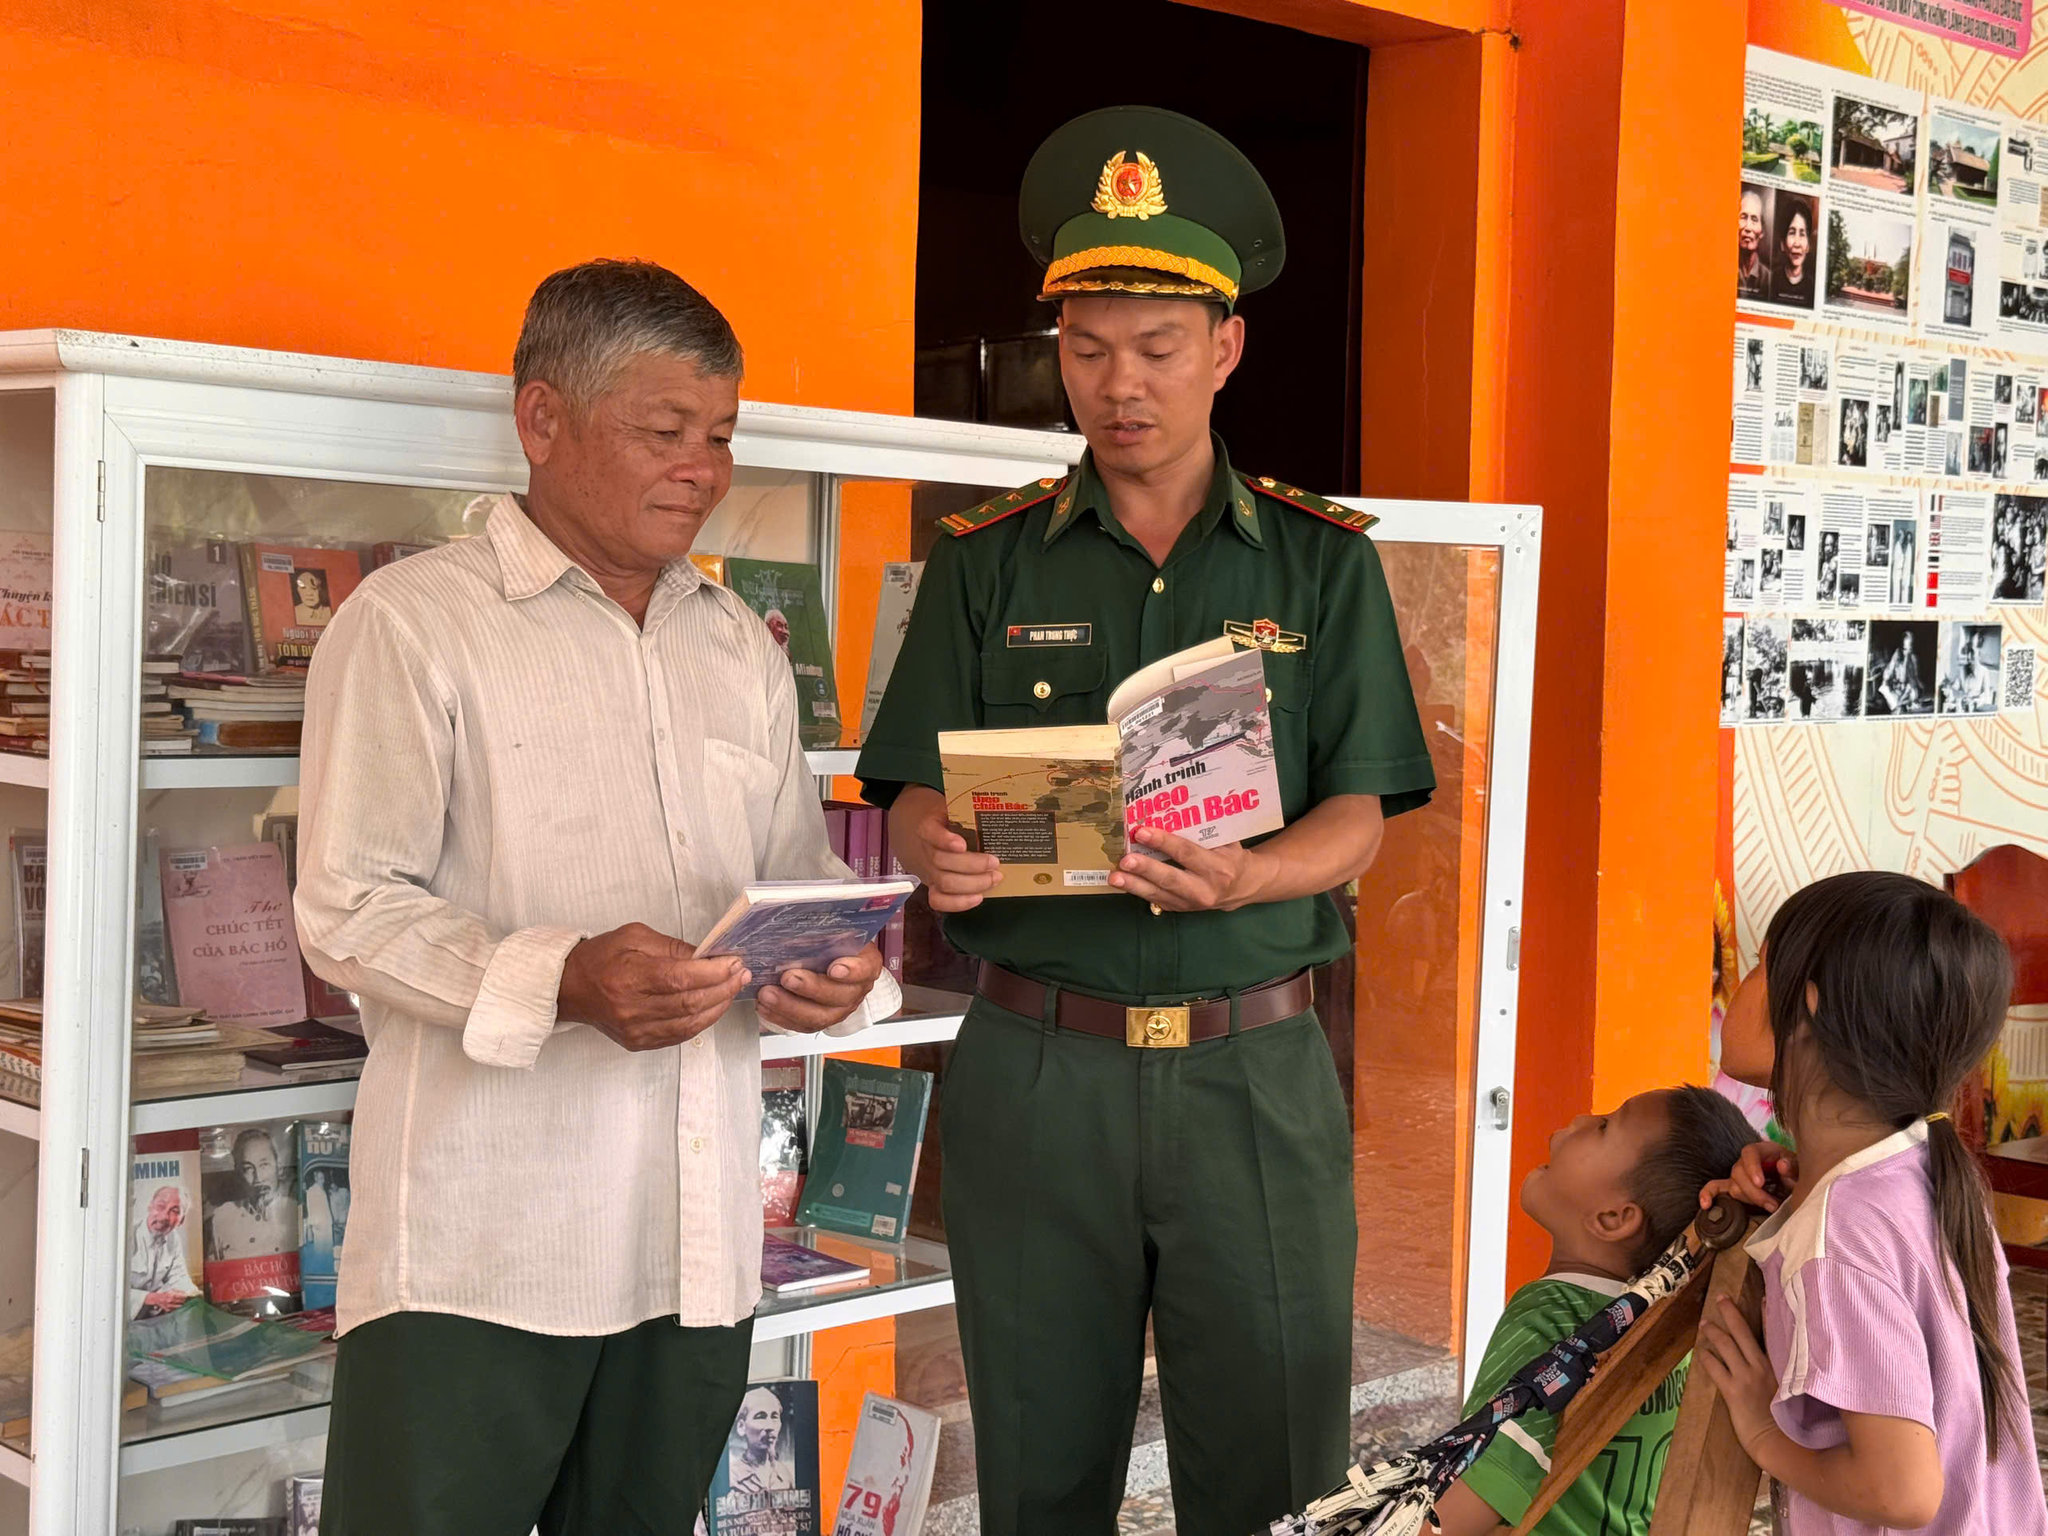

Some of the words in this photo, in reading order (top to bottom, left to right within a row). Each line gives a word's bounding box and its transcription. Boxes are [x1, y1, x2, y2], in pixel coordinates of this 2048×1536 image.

[213, 545, 220, 562] 1
[1124, 777, 1162, 806] Hành
[1165, 761, 1207, 786] trình
[1126, 785, 1189, 825] theo
[1203, 788, 1260, 823] Bác
[206, 919, 249, 936] CHÚC
[254, 915, 285, 932] TẾT
[193, 942, 224, 958] CỦA
[228, 941, 260, 956] BÁC
[133, 1160, 180, 1180] MINH
[844, 1483, 882, 1519] 79
